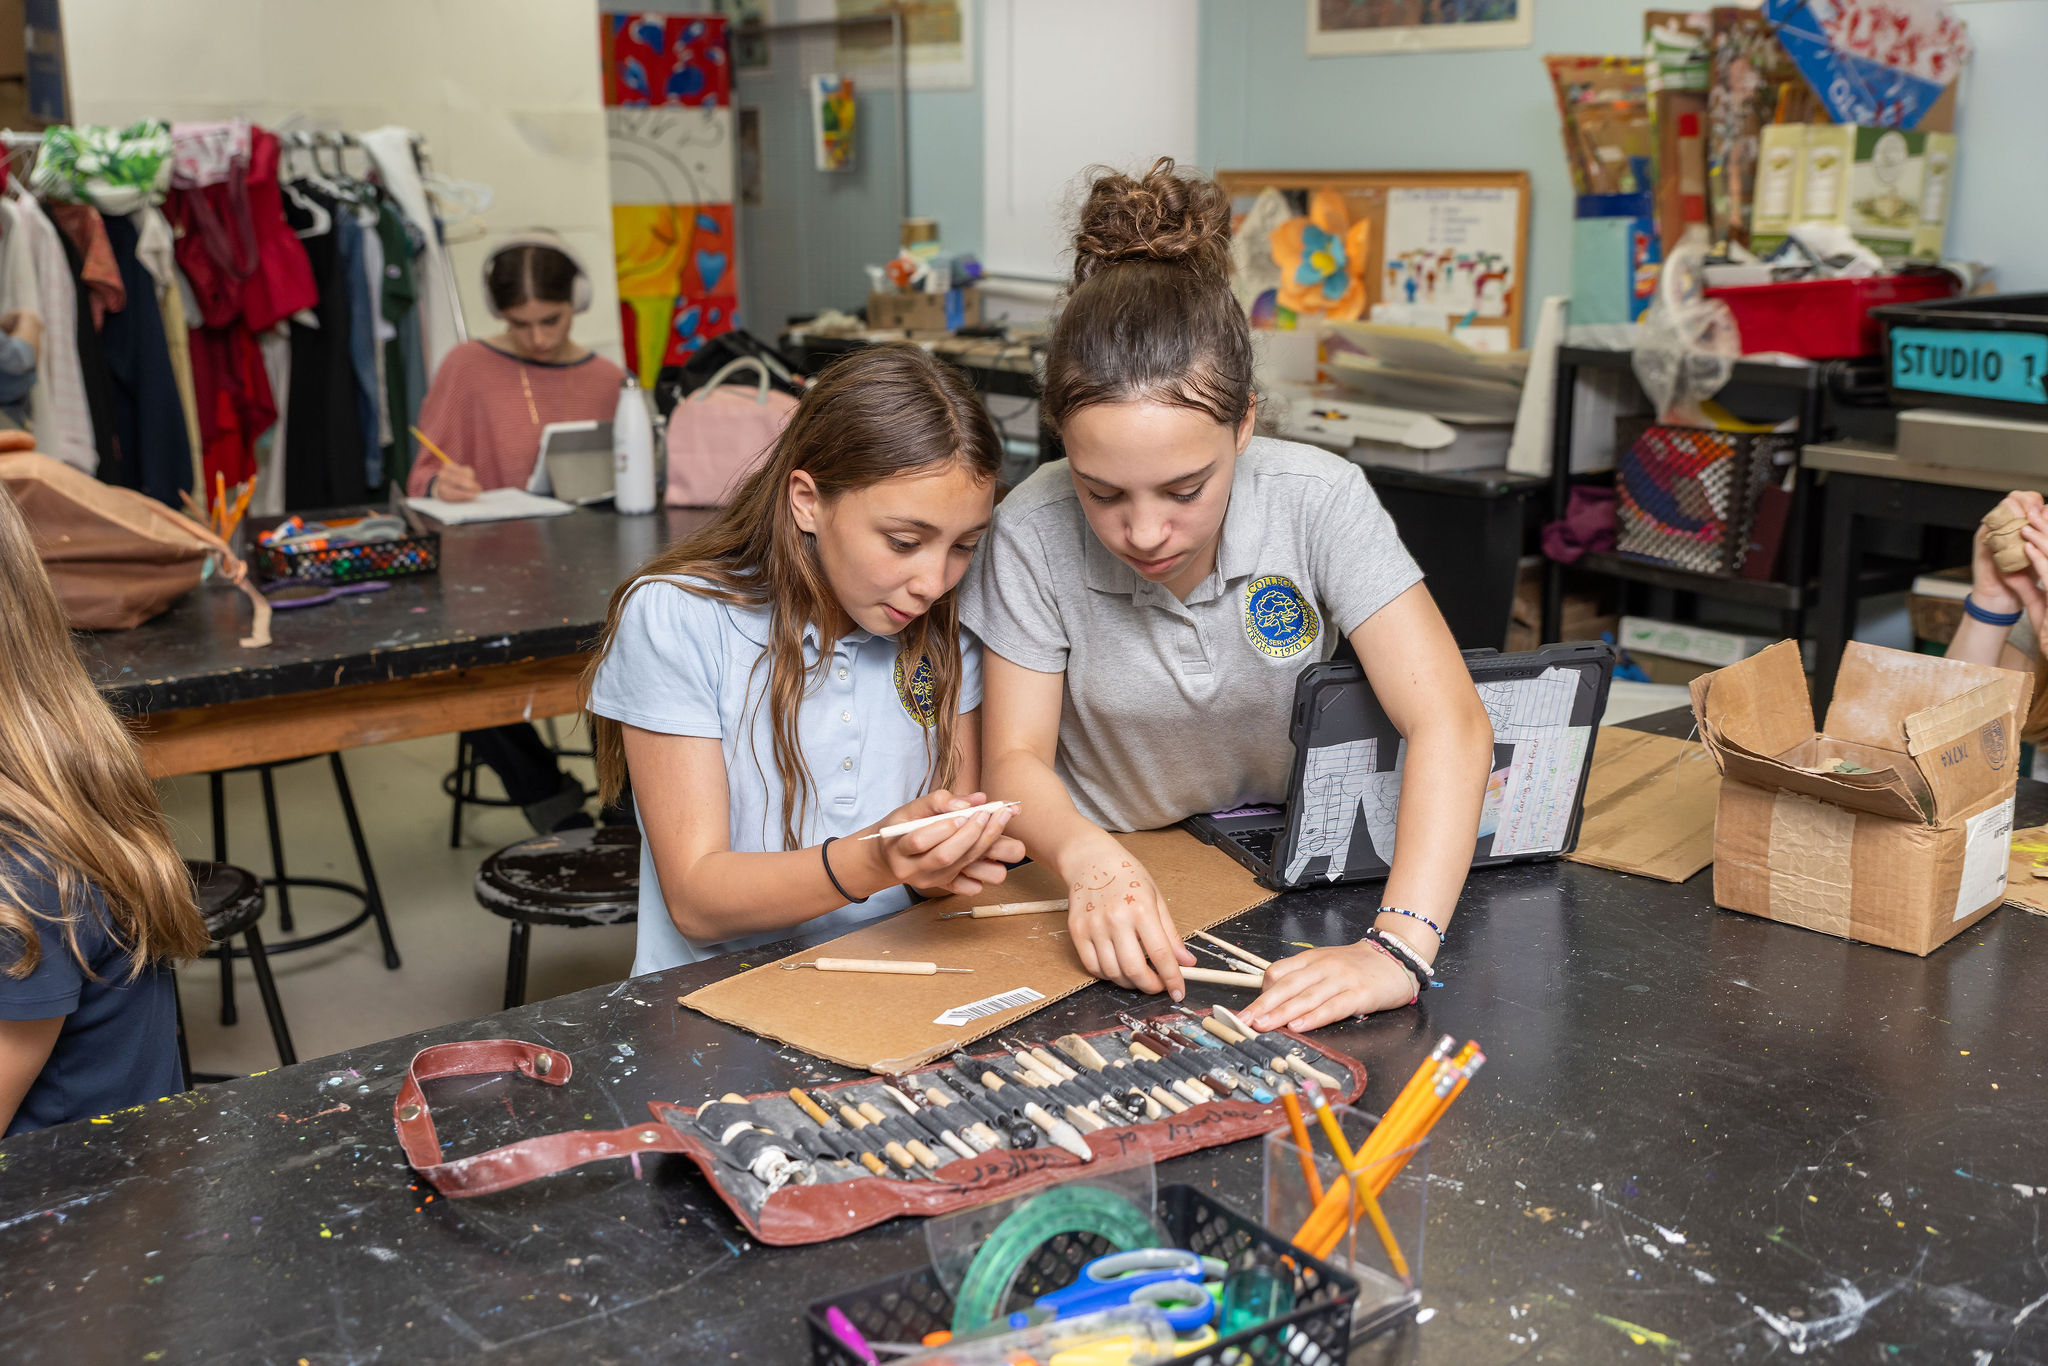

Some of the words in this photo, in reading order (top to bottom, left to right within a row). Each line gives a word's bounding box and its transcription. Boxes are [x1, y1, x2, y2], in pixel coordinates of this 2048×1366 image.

[1900, 345, 2003, 382] STUDIO
[1269, 635, 1298, 647] SERVICE
[1280, 643, 1302, 656] 1970
